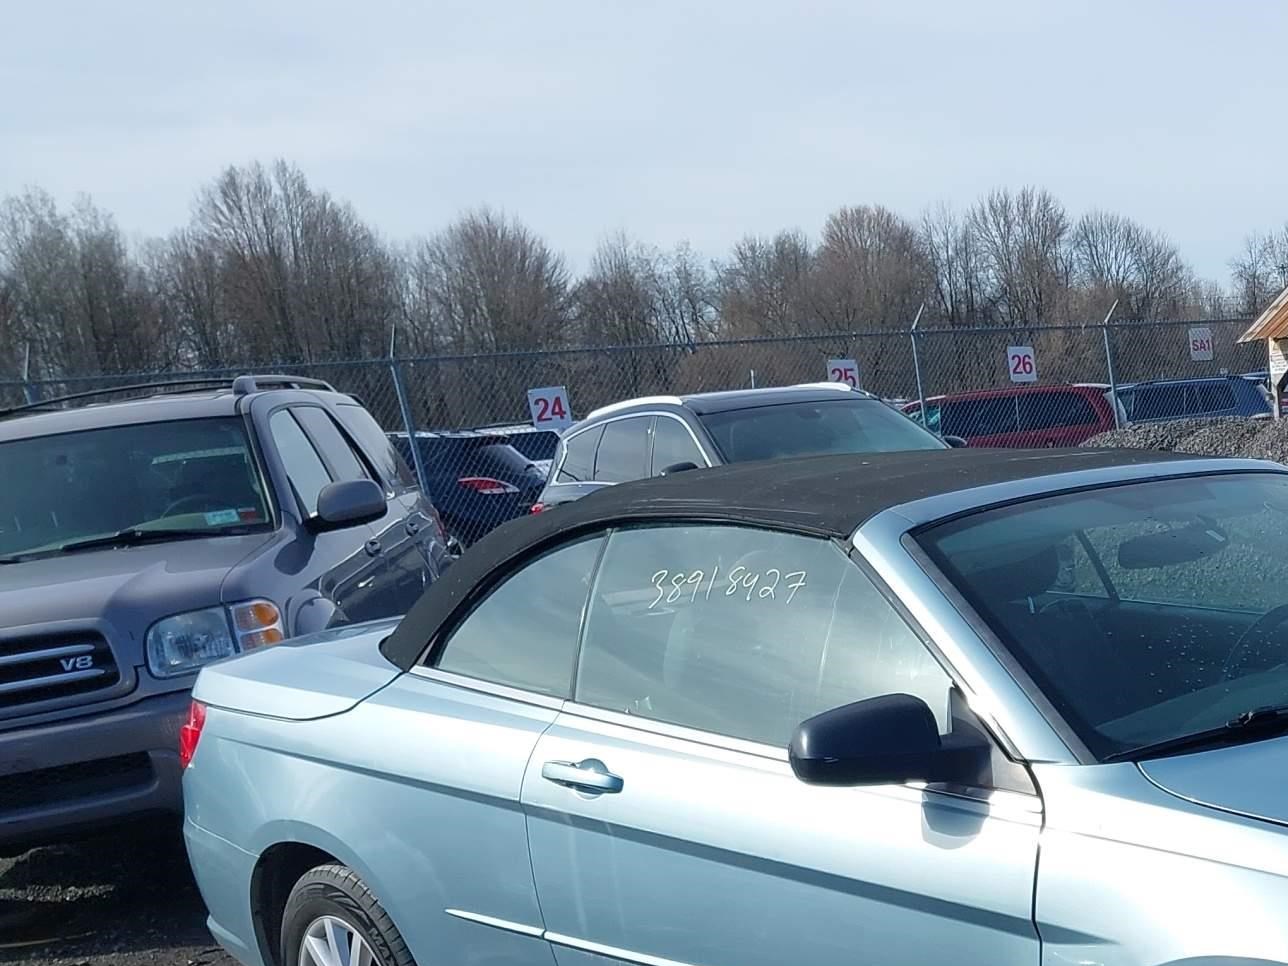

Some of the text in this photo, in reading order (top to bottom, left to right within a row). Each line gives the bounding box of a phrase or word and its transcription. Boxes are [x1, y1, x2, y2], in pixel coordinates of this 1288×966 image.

[1192, 339, 1211, 352] SA1
[1011, 354, 1034, 375] 26
[831, 367, 857, 387] 25
[533, 396, 567, 422] 24
[60, 655, 94, 672] V8
